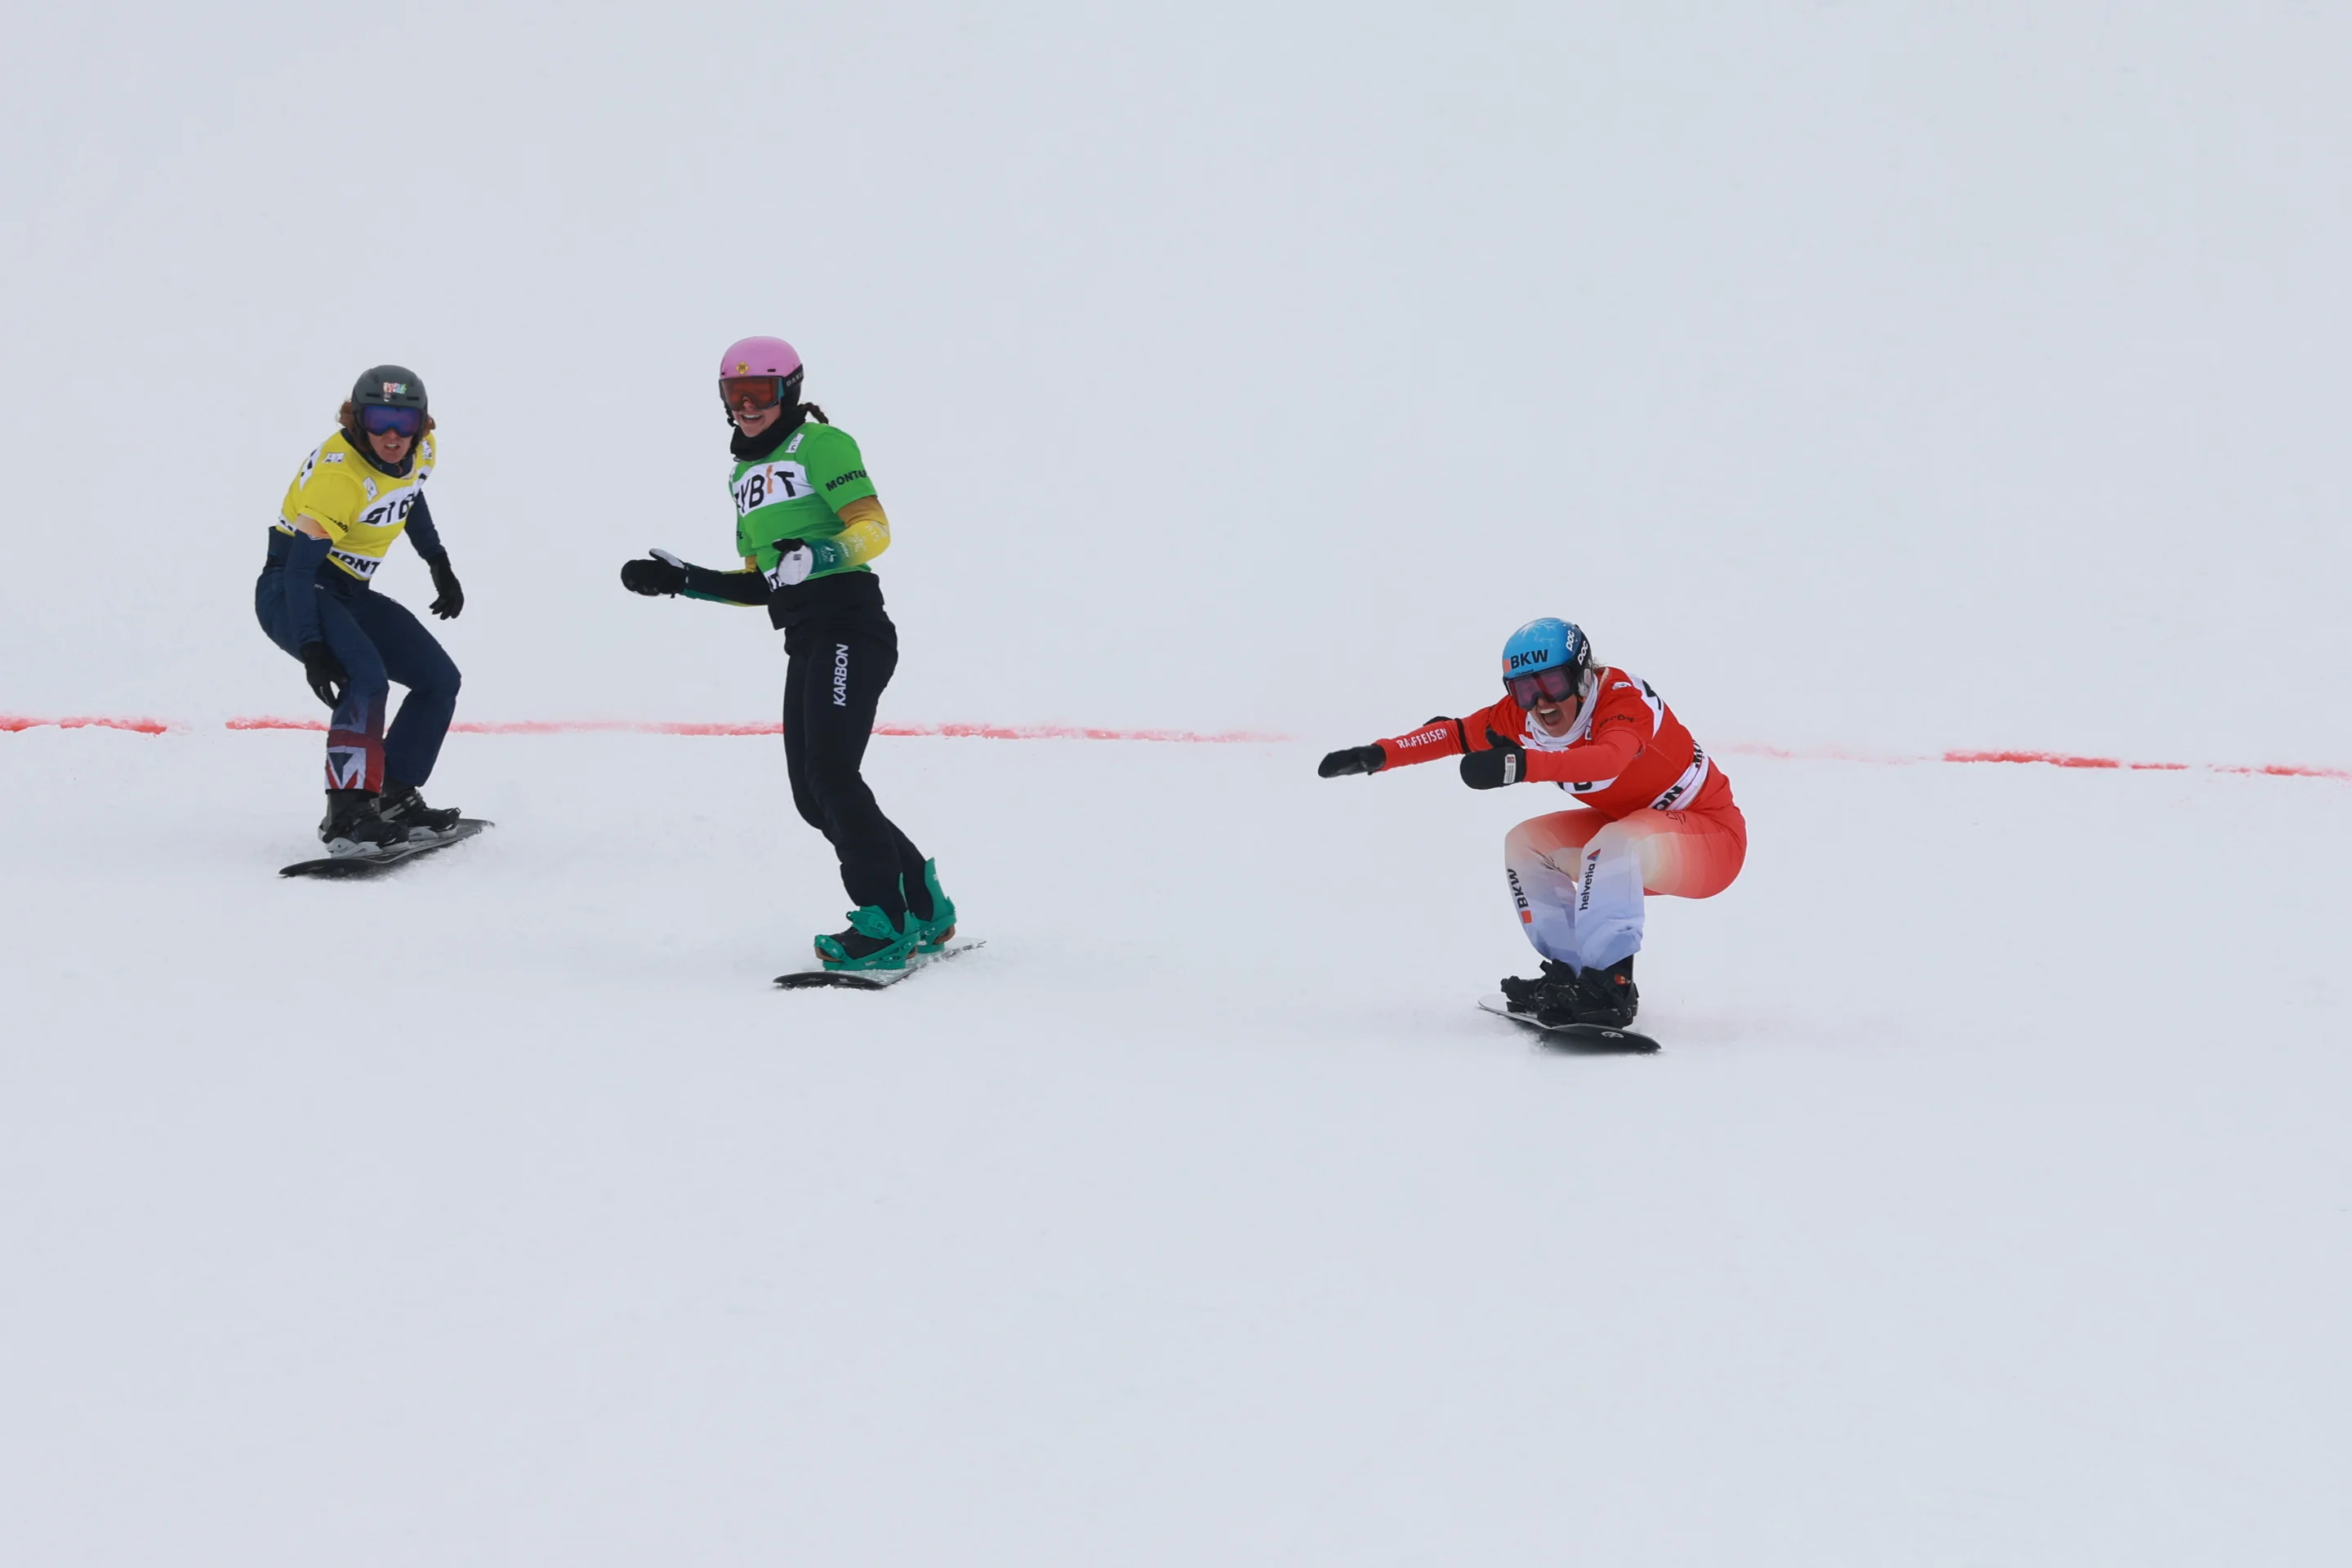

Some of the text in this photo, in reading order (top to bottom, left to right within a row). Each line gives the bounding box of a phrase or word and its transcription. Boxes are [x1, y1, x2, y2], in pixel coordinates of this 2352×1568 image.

[833, 644, 849, 706] KARBON
[1510, 649, 1548, 670] BKW
[1508, 868, 1529, 908] BKW
[1579, 863, 1596, 911] helvetia
